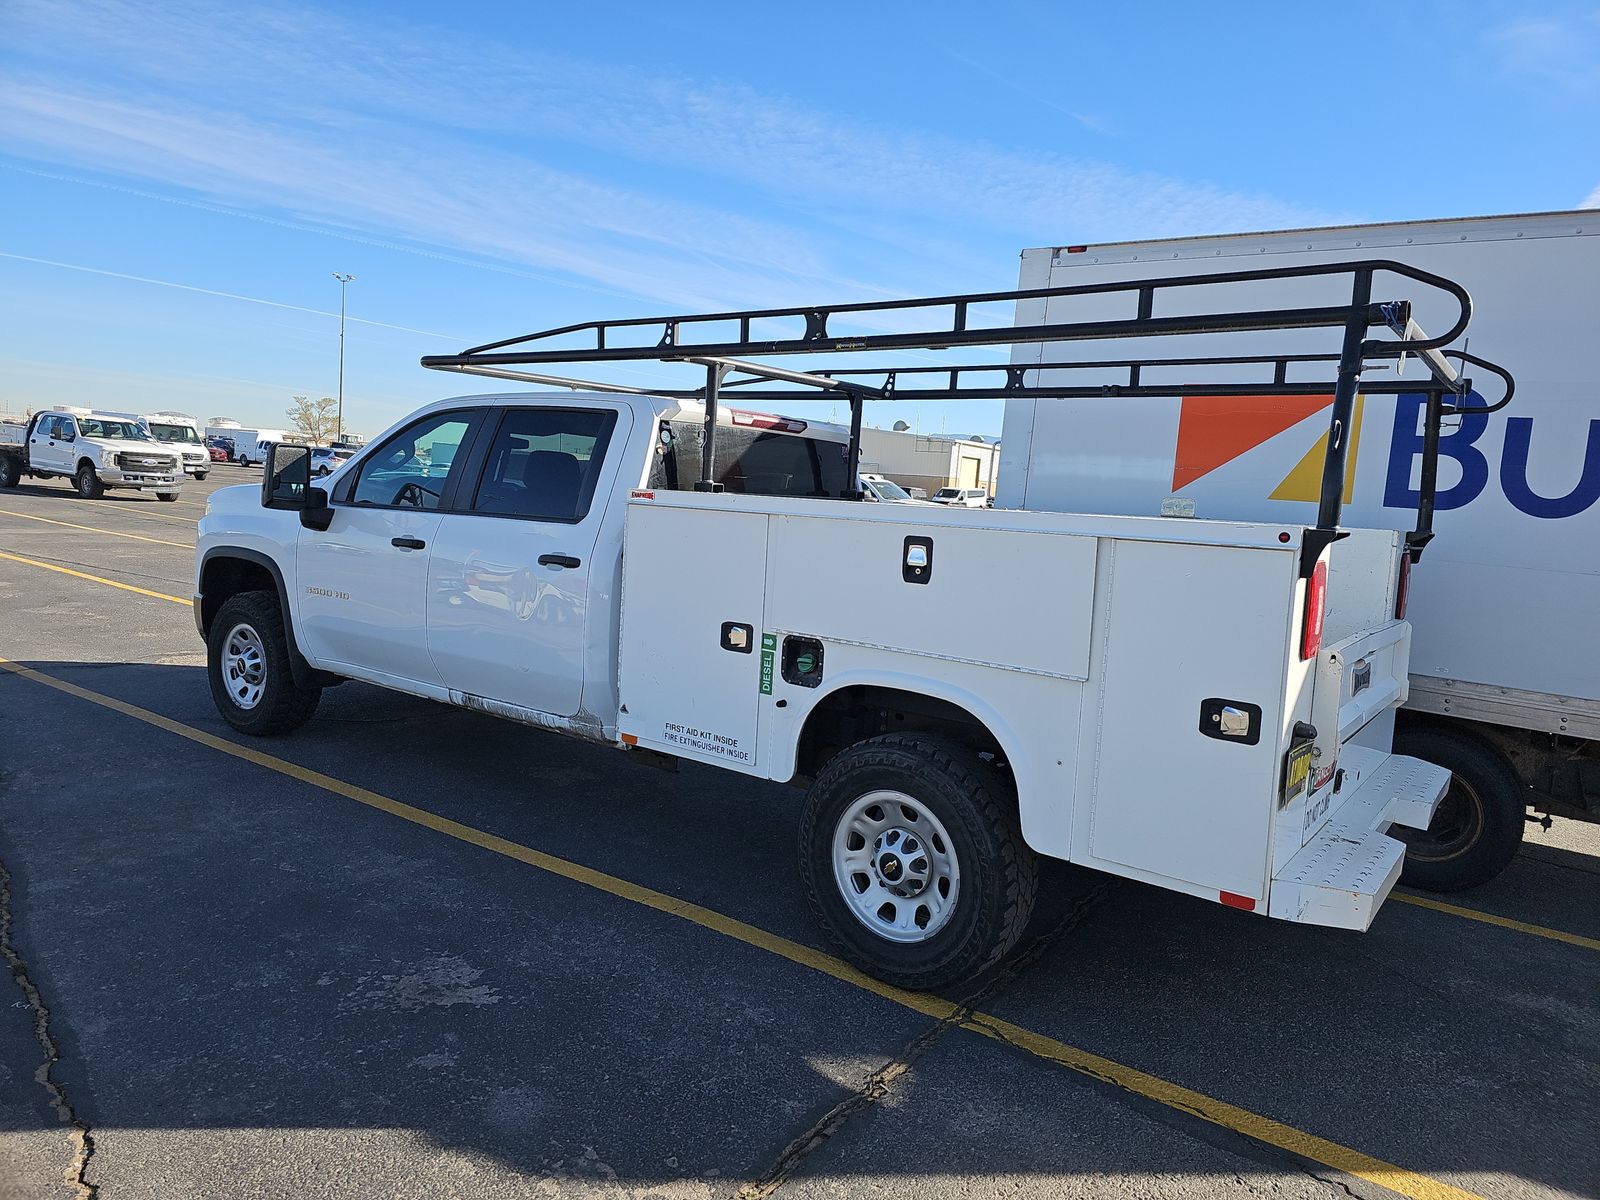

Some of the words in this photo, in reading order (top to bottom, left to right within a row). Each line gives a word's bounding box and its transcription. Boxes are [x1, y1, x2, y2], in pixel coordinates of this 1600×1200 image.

[1382, 387, 1600, 519] Bu
[305, 586, 333, 597] 3500
[762, 654, 772, 692] DIESEL
[664, 732, 678, 743] FIRE
[680, 736, 725, 755] EXTINGUISHER
[727, 748, 749, 761] INSIDE
[665, 722, 685, 733] FIRST
[686, 727, 699, 737] AID
[700, 730, 712, 740] KIT
[713, 734, 739, 748] INSIDE
